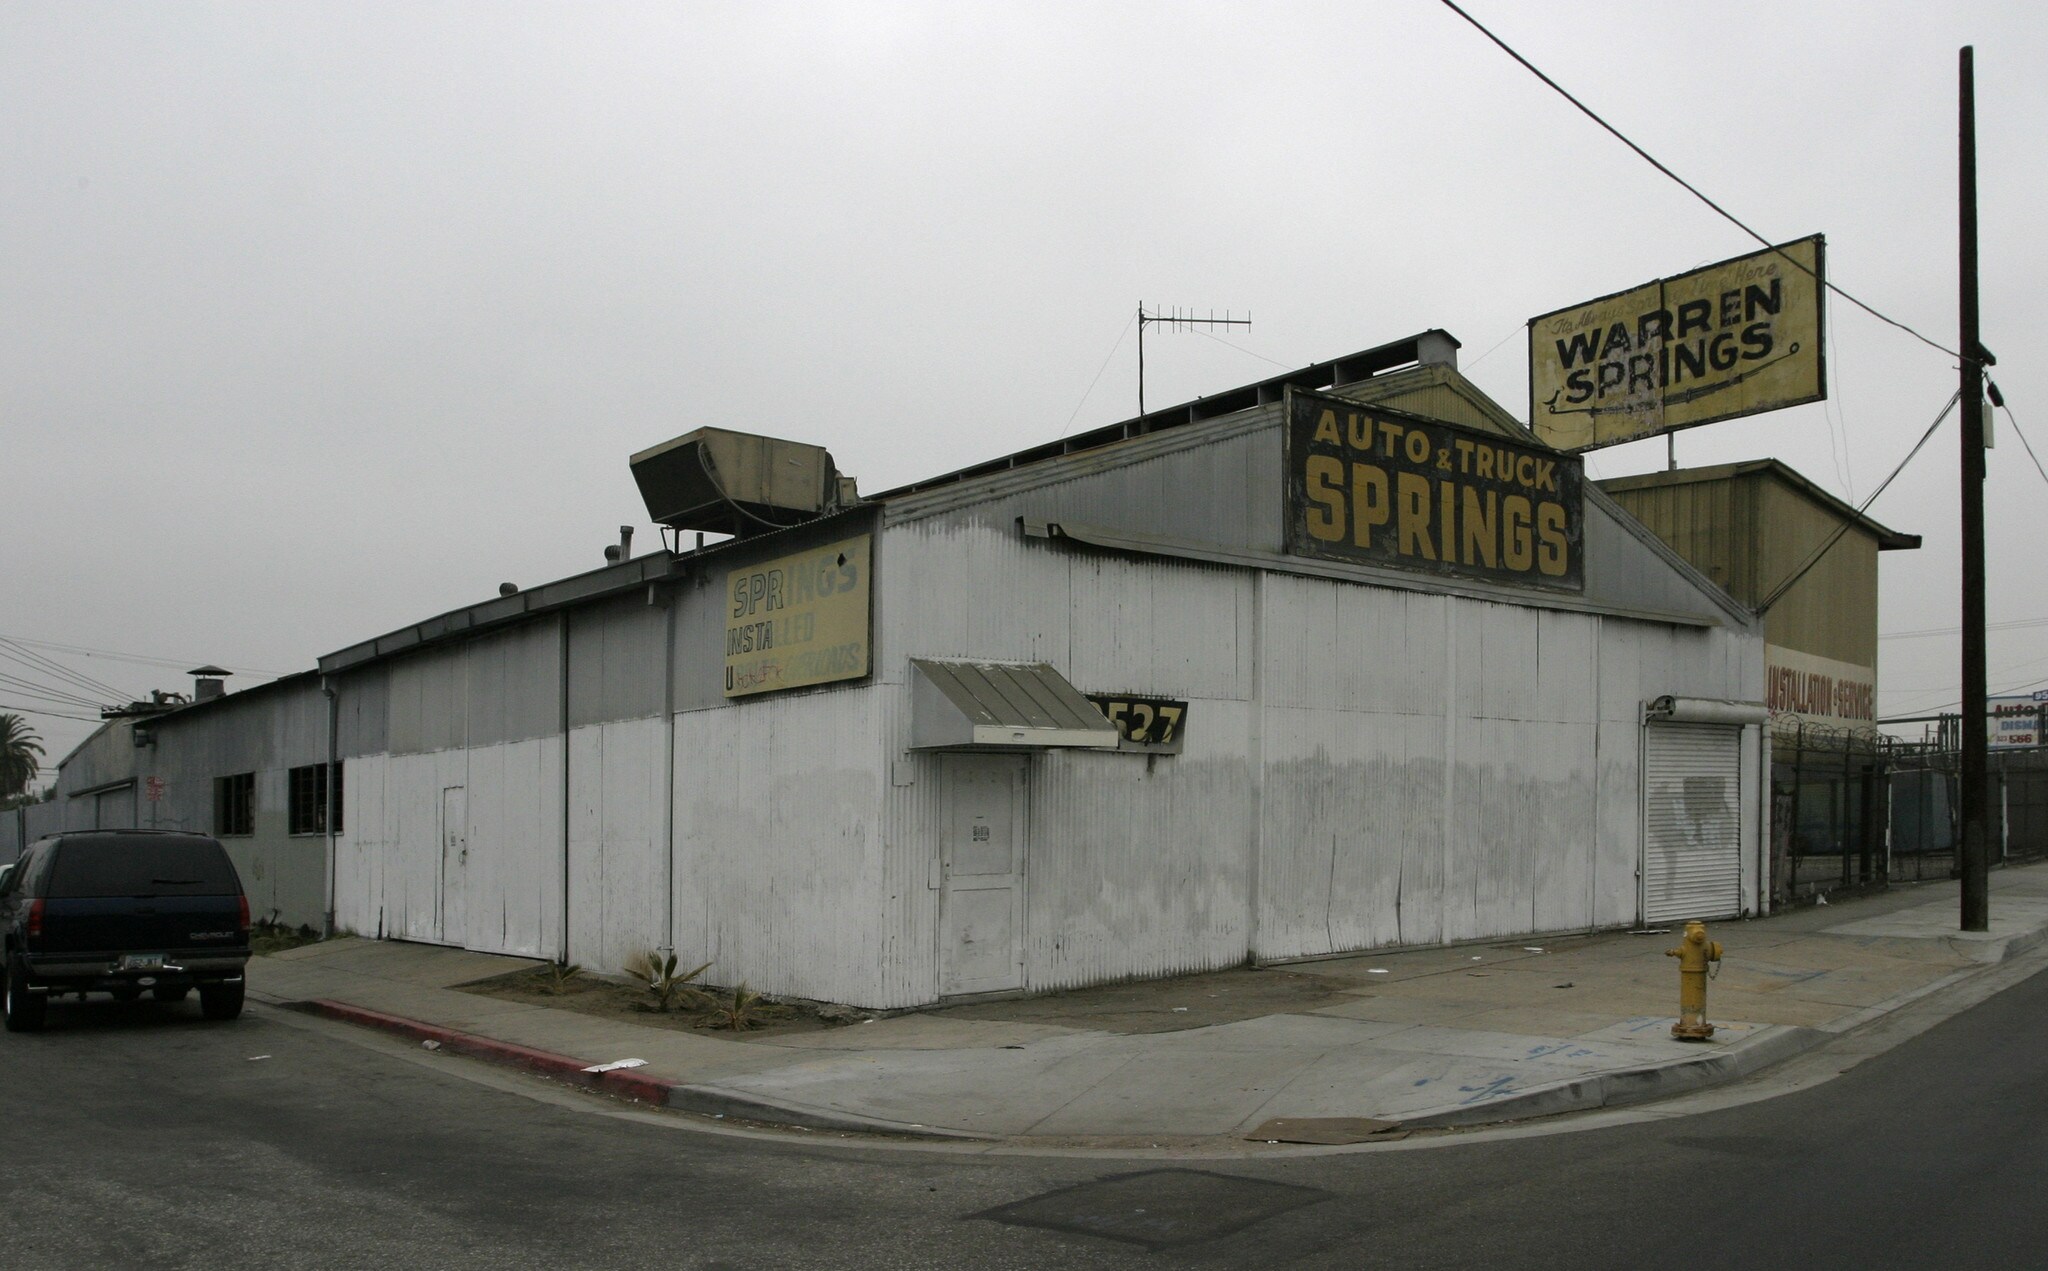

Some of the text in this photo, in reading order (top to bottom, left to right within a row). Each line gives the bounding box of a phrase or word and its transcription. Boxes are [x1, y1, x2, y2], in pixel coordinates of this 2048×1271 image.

[1556, 278, 1782, 369] WARREN
[1565, 321, 1774, 404] SPRINGS
[1314, 408, 1557, 493] AUTO & TRUCK
[1304, 454, 1569, 577] SPRINGS
[733, 547, 859, 619] SPRINGS
[1768, 664, 1833, 717] INSTALLATION
[1838, 678, 1873, 721] SERVICE
[1995, 703, 2034, 719] Auto
